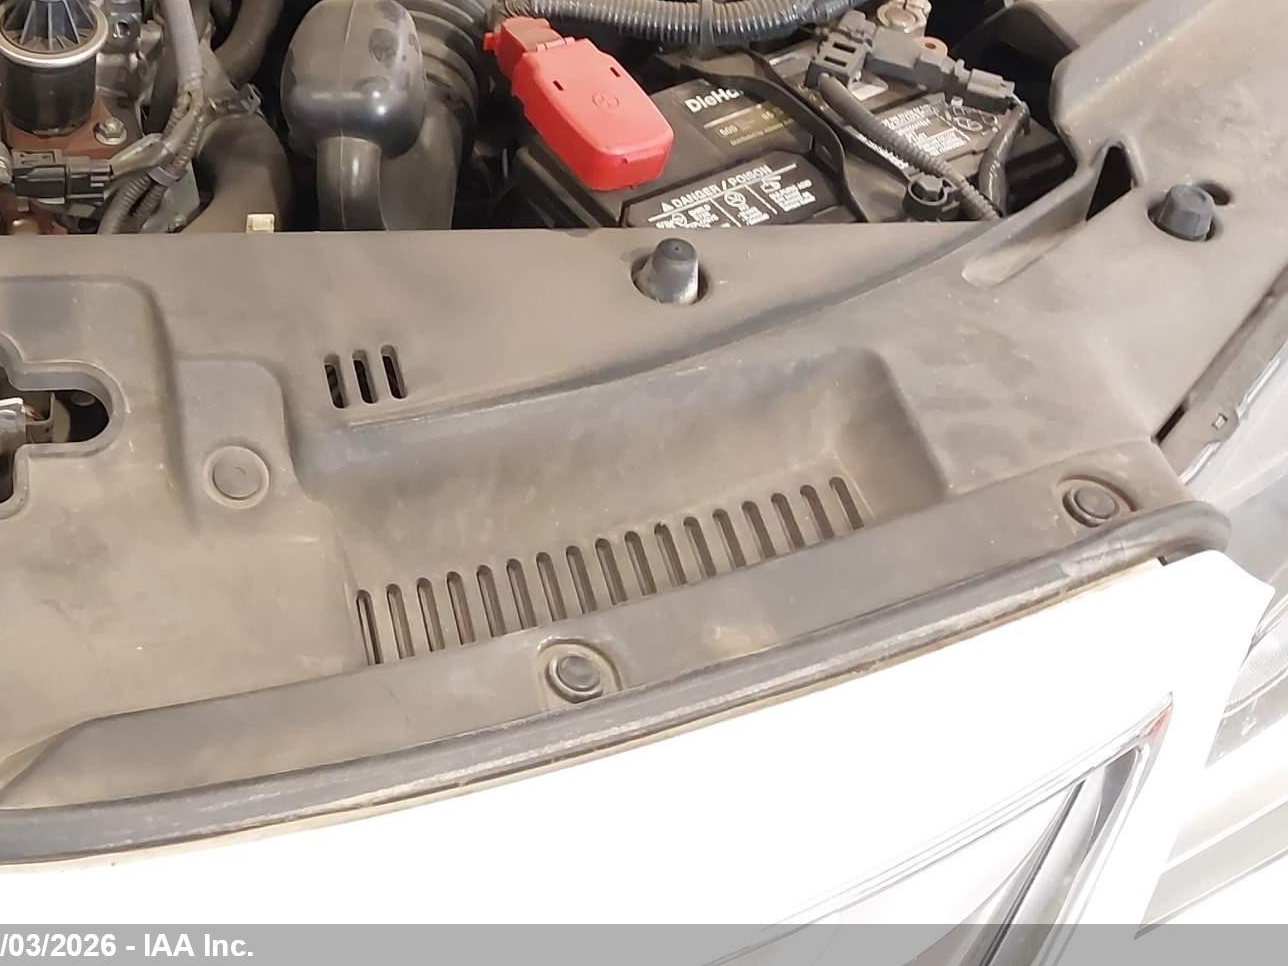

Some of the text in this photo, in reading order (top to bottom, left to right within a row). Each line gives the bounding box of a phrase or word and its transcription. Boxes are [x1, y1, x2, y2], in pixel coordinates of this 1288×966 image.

[685, 87, 744, 113] DieHa
[671, 184, 721, 208] DANGER
[727, 164, 774, 188] POISON
